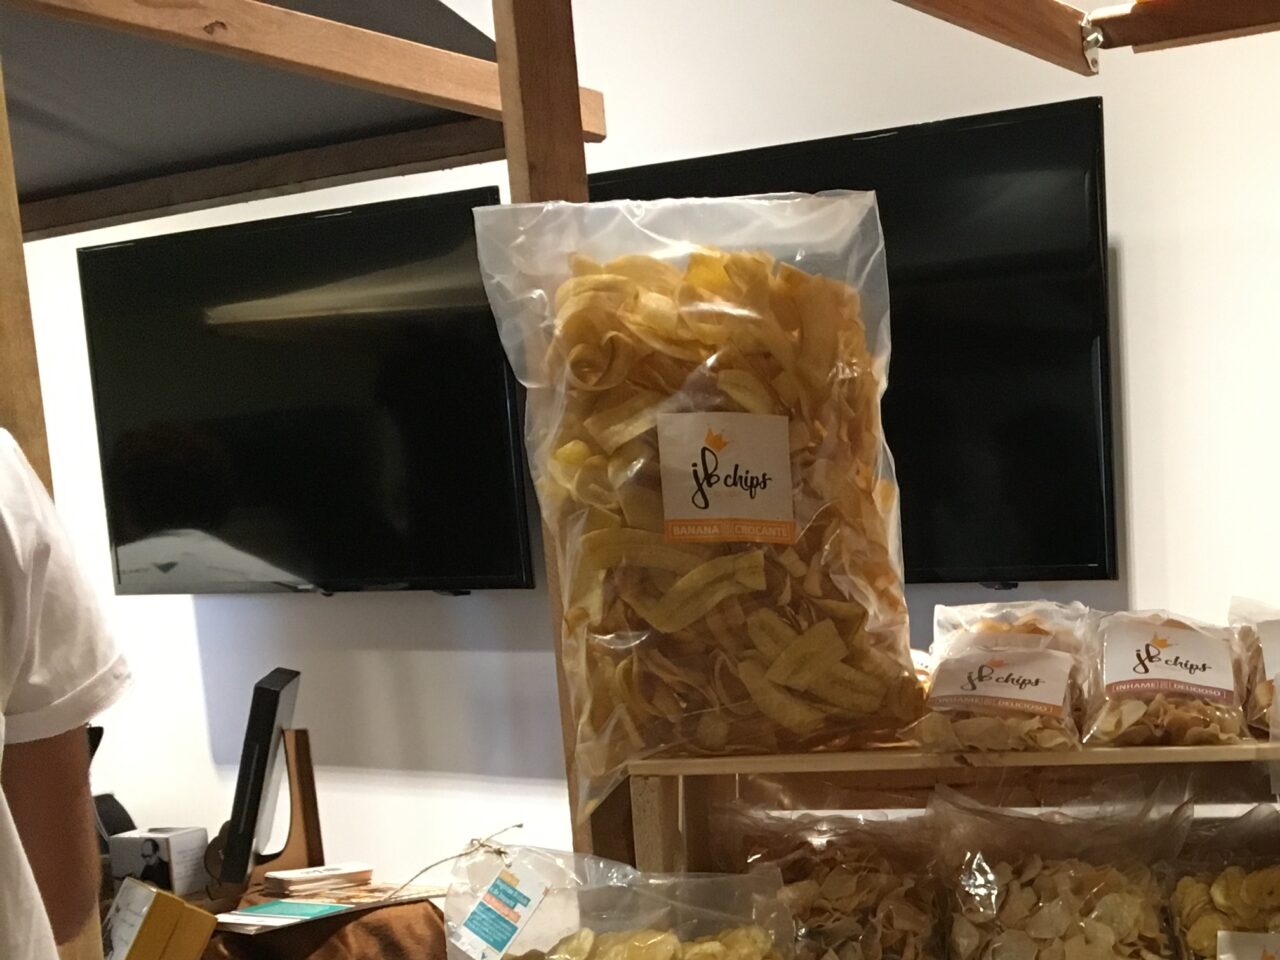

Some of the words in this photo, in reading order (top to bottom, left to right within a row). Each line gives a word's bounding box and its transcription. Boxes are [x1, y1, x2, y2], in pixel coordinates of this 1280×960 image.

[691, 446, 720, 509] jb
[724, 464, 772, 499] chips
[1133, 644, 1161, 674] jb
[1165, 656, 1212, 674] chips
[960, 665, 994, 691] jb
[995, 673, 1045, 689] chips
[1116, 682, 1156, 690] INHAME
[1174, 683, 1221, 696] DELICIOSO
